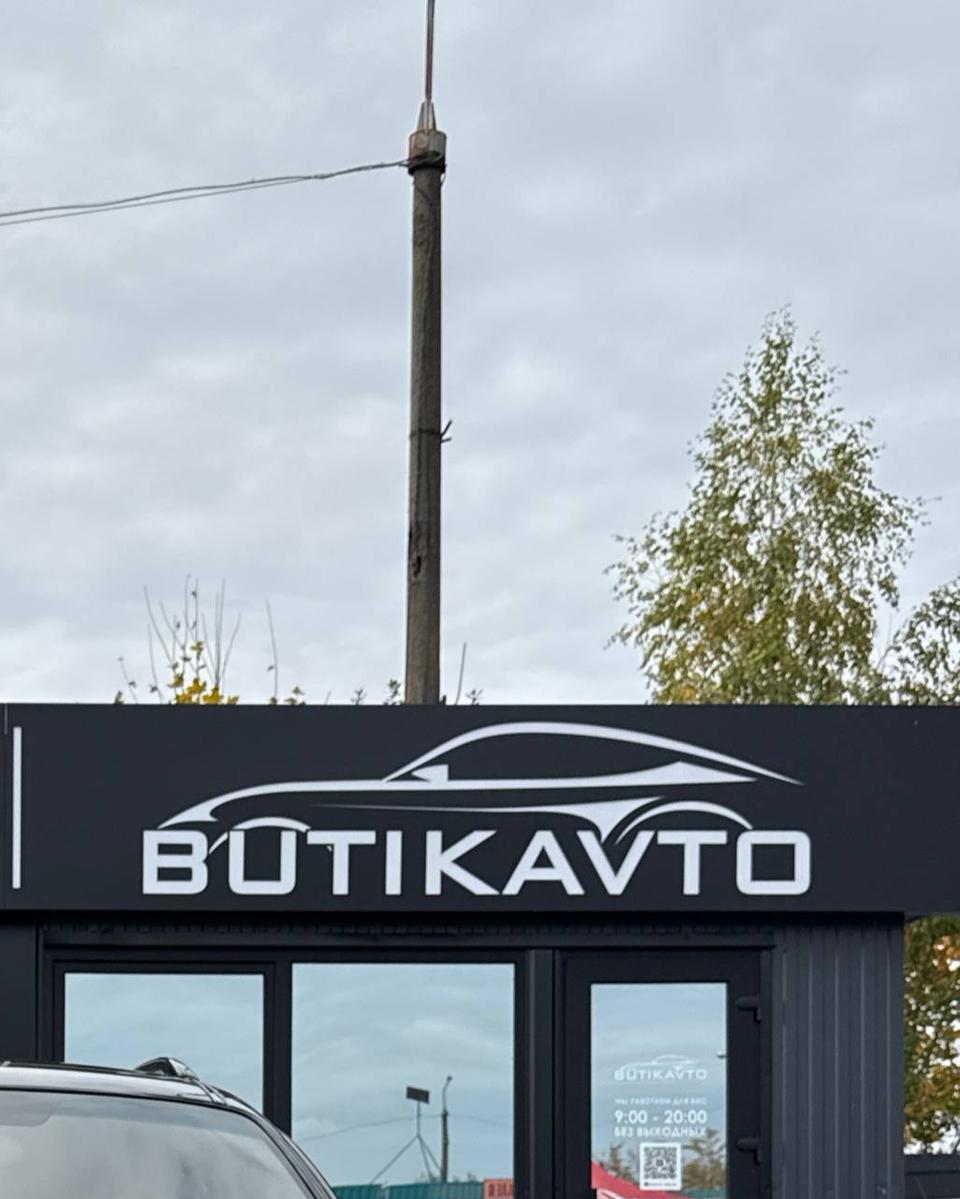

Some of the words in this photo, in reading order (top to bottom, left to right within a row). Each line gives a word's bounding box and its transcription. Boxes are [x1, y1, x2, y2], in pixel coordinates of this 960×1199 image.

[142, 830, 811, 896] BUTIKAVTO
[614, 1069, 708, 1081] BUTIKAVTO
[614, 1110, 648, 1124] 9:00
[664, 1110, 708, 1124] 20:00
[614, 1126, 633, 1137] БЕЗ
[636, 1126, 706, 1138] ВЫХОДНЫХ
